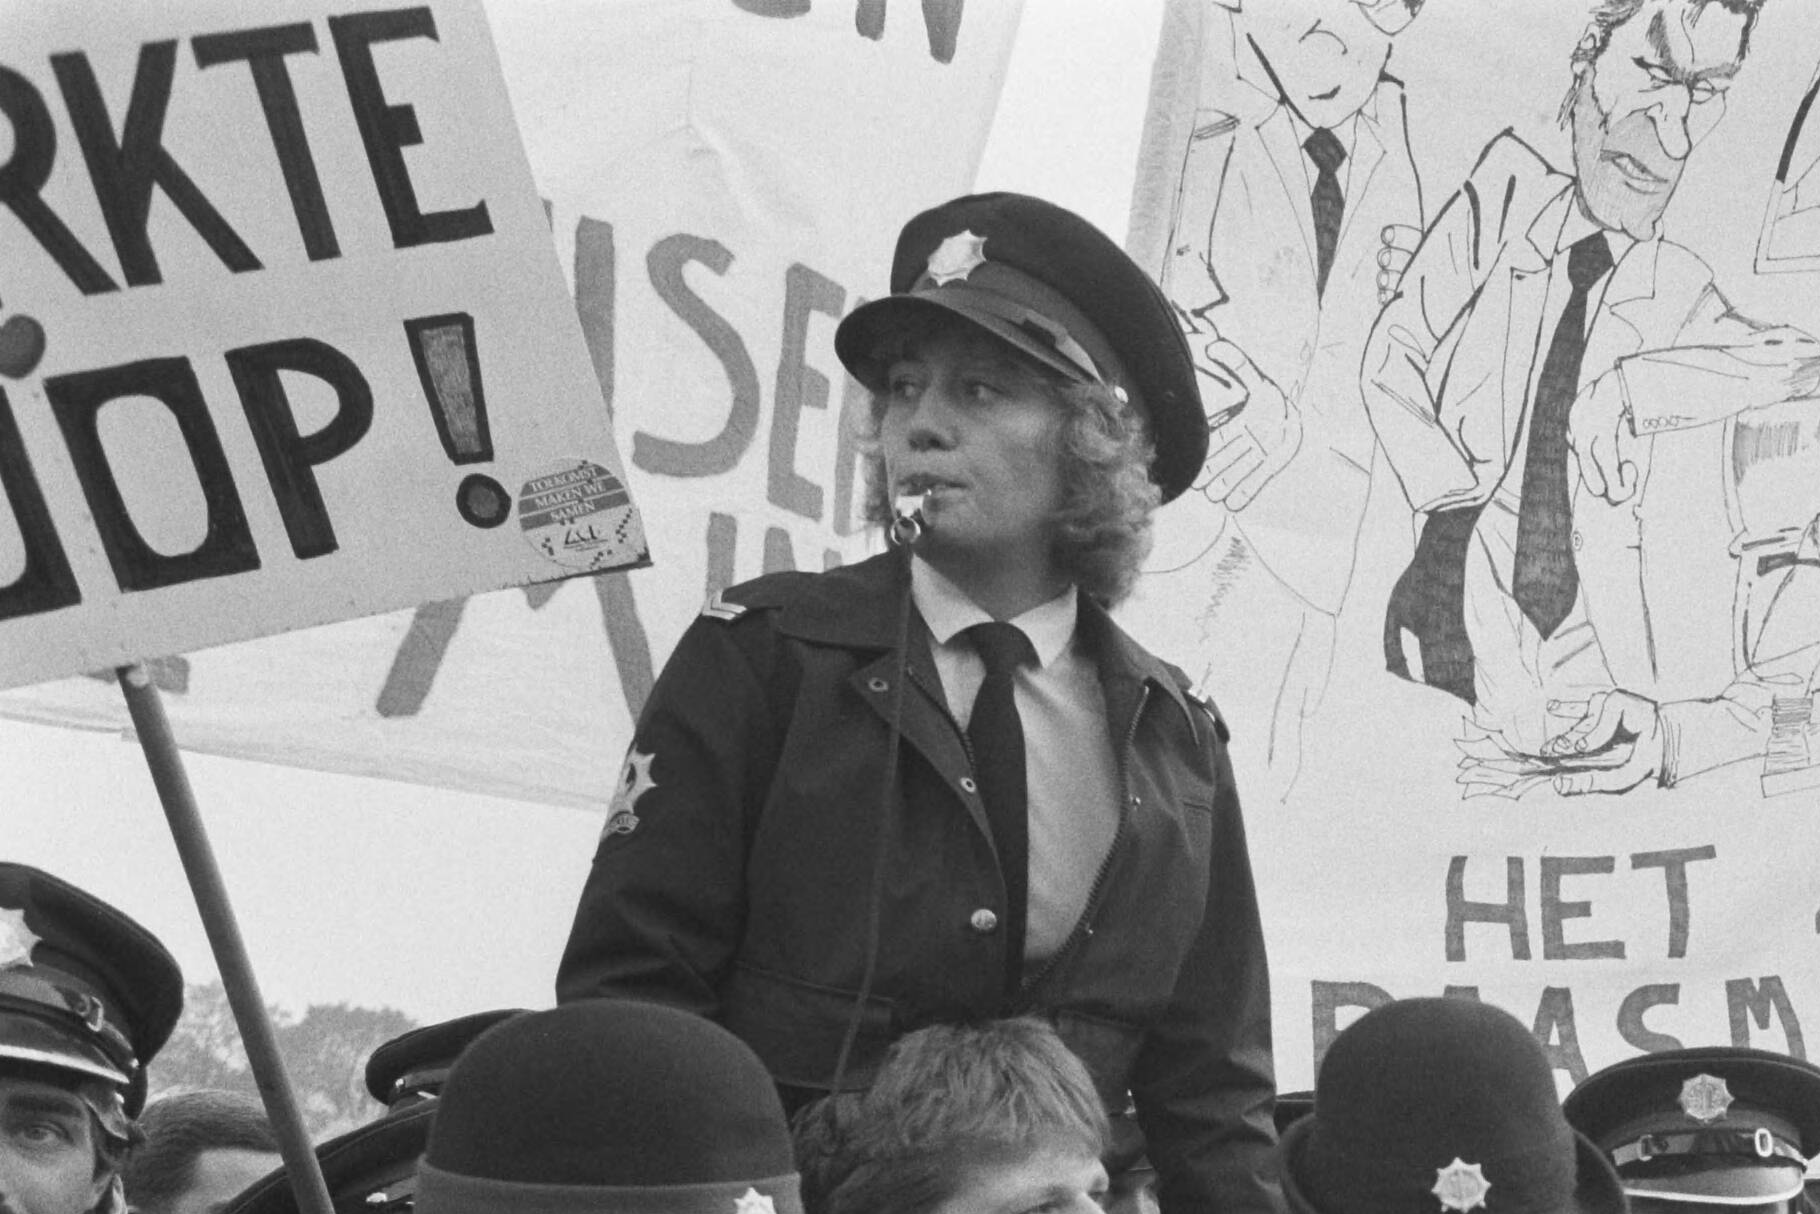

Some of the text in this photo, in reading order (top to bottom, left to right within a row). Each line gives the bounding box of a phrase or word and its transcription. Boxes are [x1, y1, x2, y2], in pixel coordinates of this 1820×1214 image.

[535, 486, 583, 508] MAKEN
[550, 499, 596, 521] SAMEN
[1445, 845, 1717, 962] HET
